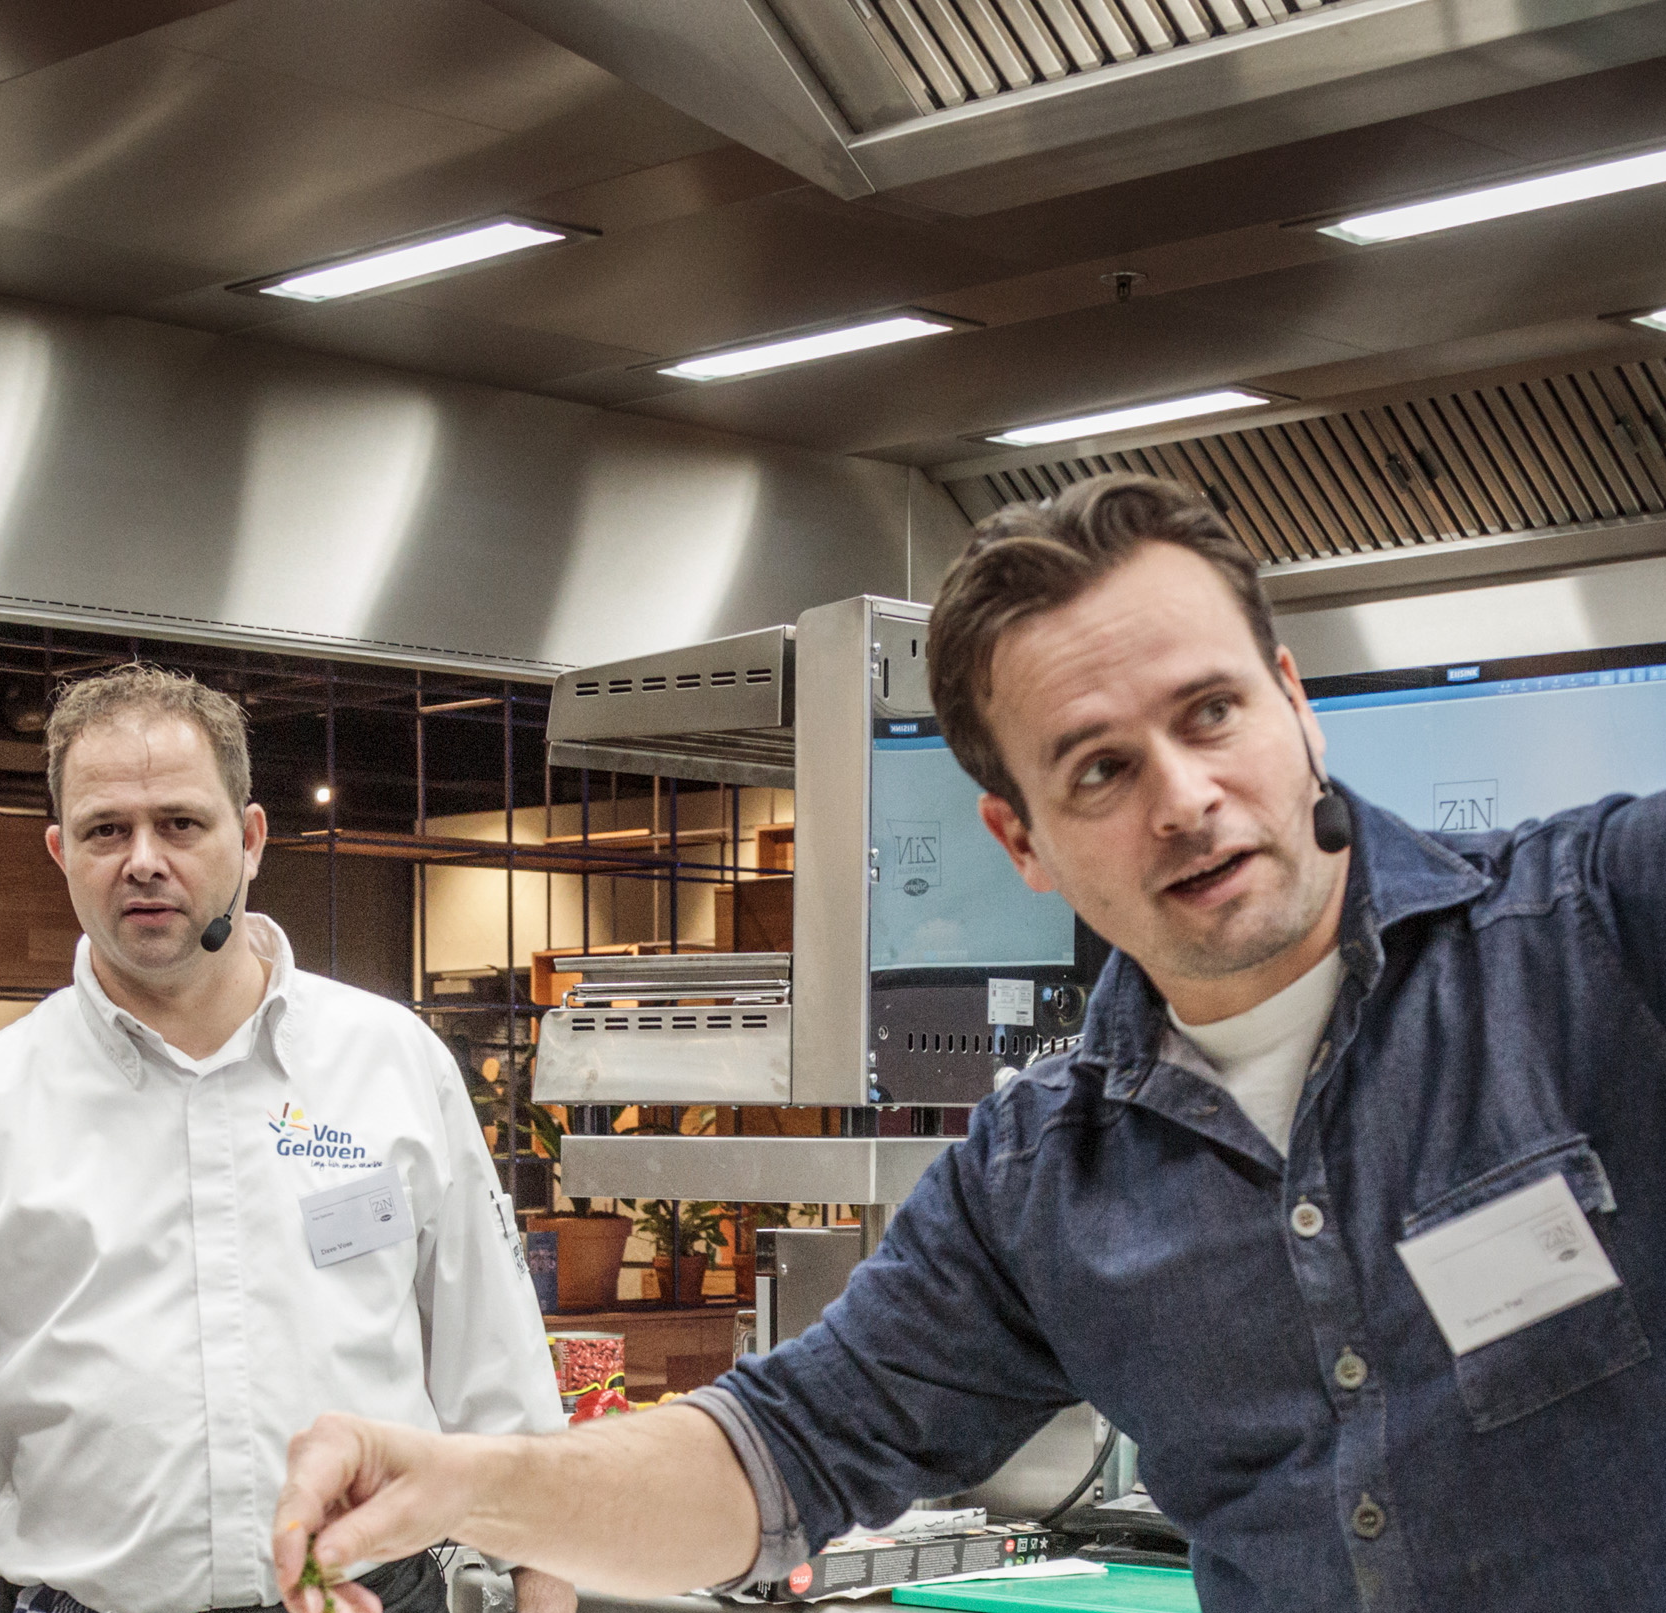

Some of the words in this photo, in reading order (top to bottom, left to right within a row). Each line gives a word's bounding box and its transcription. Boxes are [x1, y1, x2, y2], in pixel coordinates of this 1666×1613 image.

[1439, 797, 1495, 832] ZiN
[313, 1123, 352, 1145] Van
[275, 1138, 366, 1160] Geloven
[372, 1197, 394, 1214] ZiN
[792, 1574, 810, 1586] SAGA
